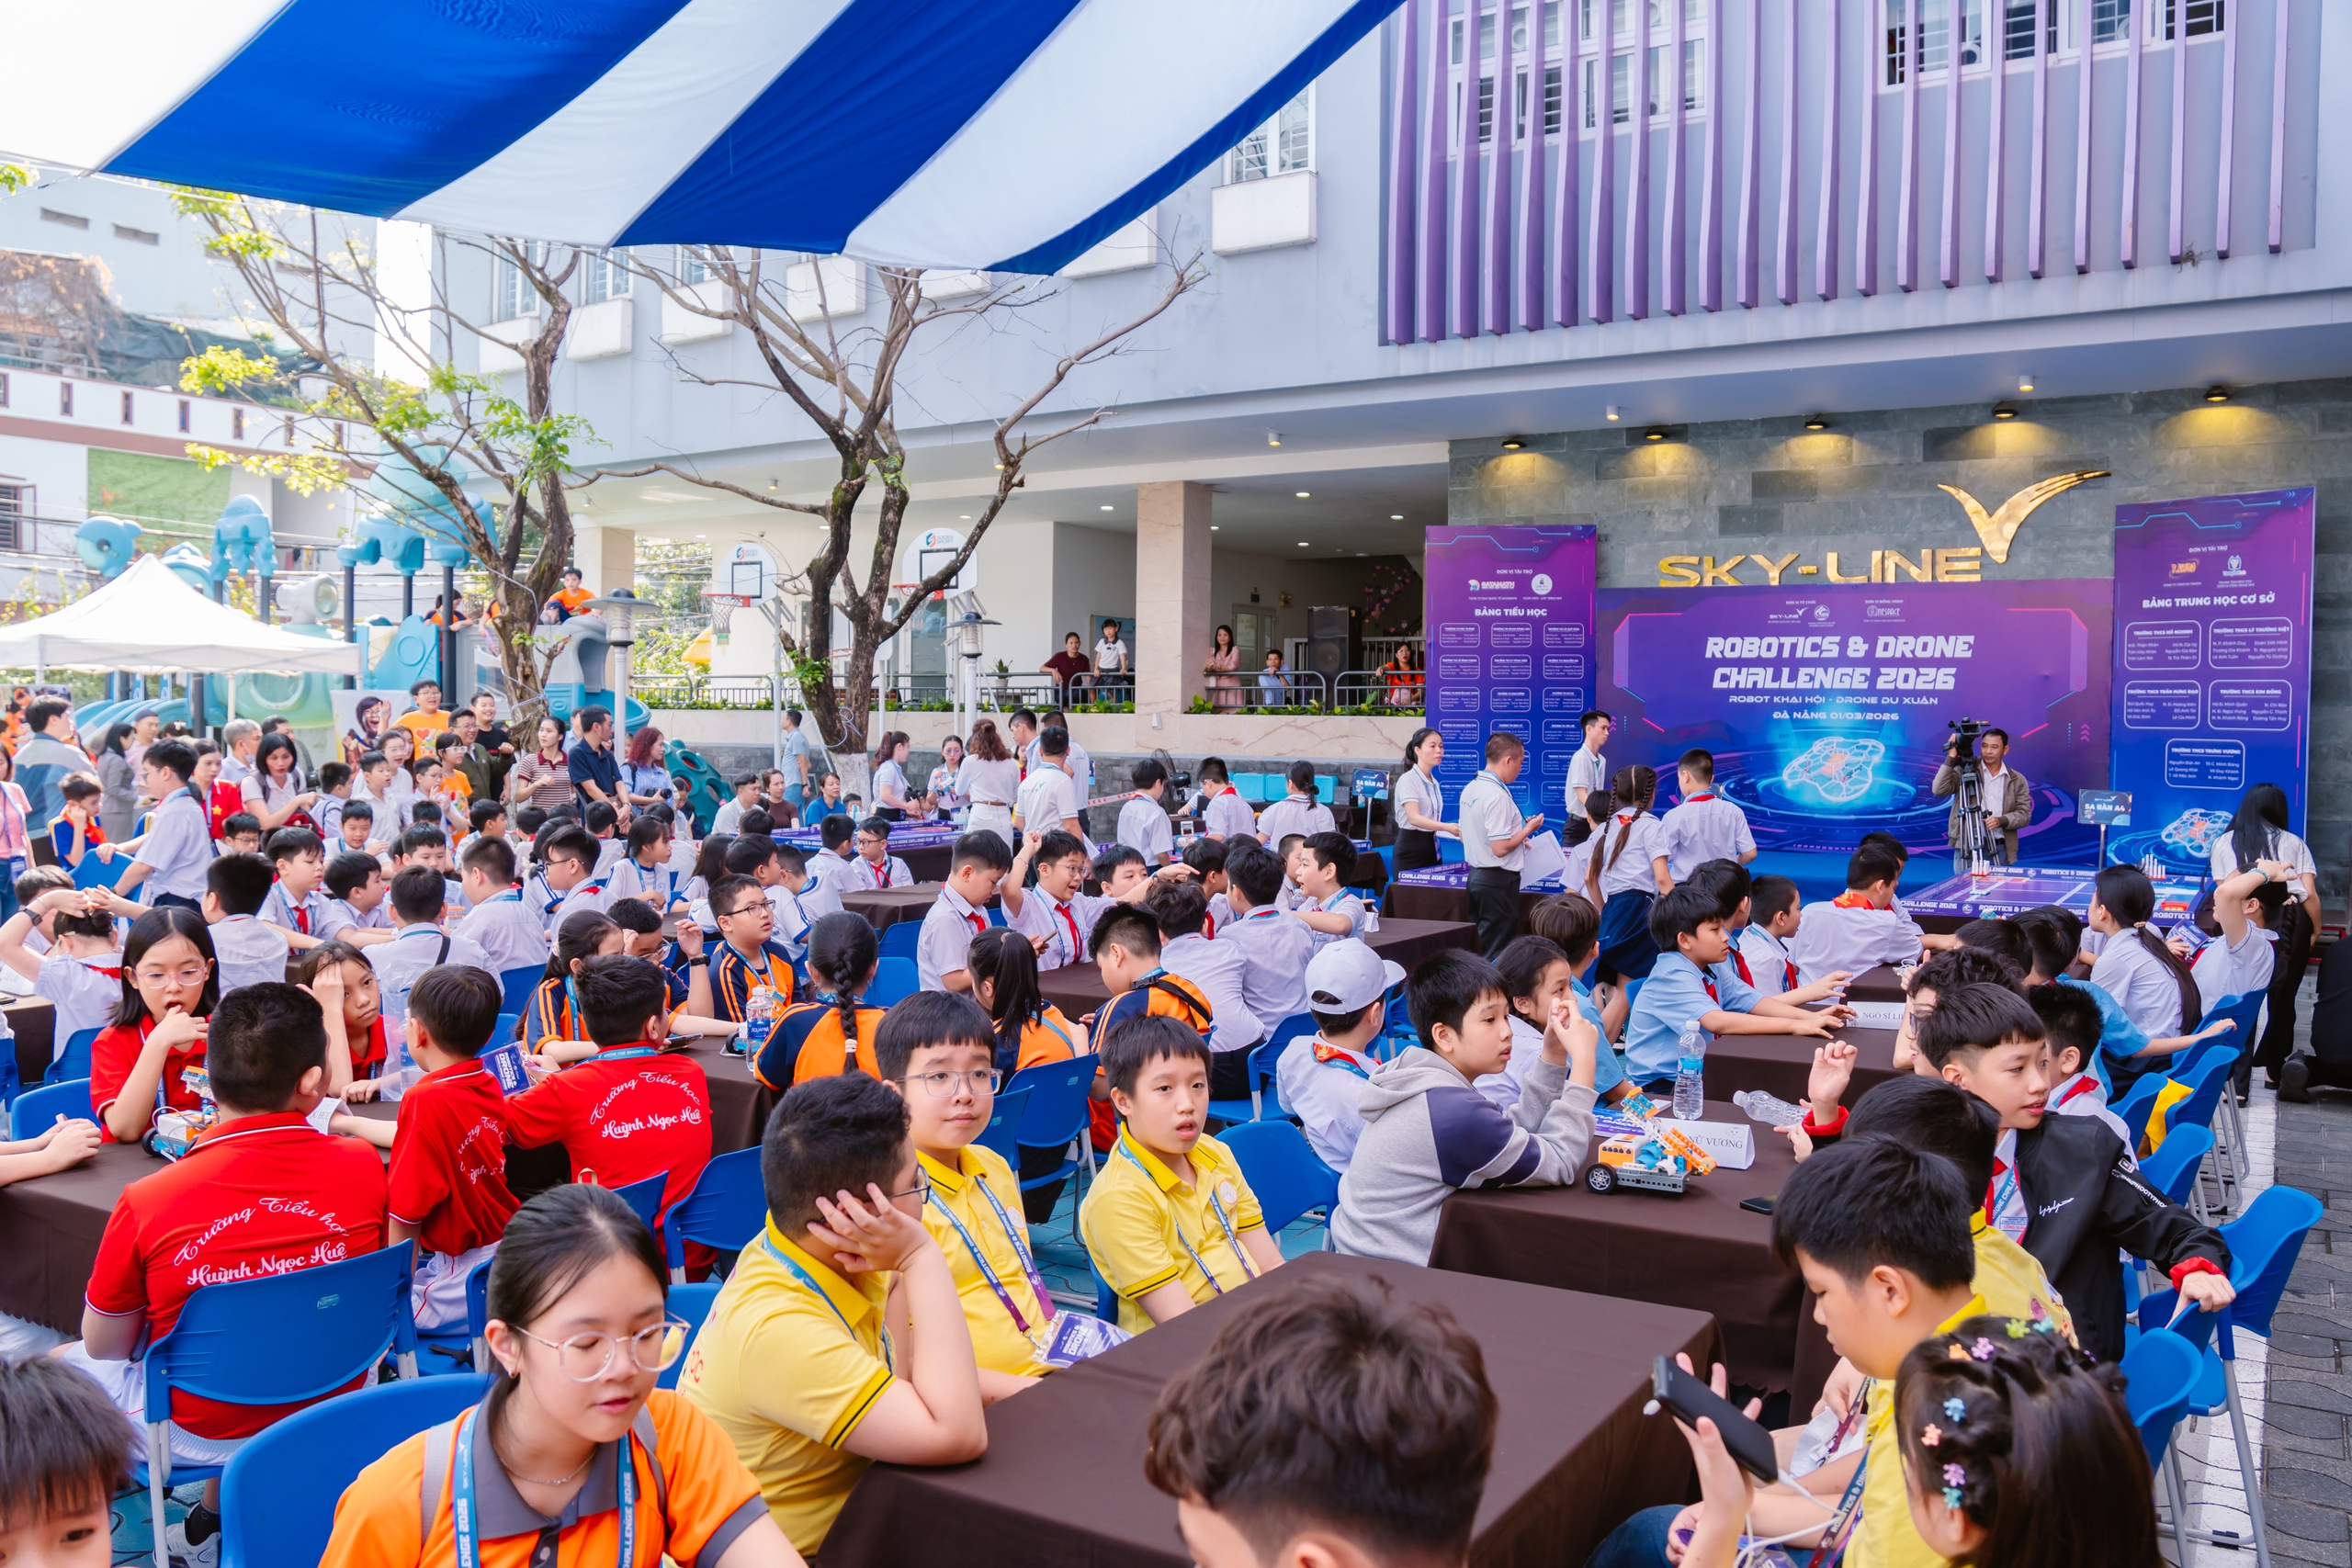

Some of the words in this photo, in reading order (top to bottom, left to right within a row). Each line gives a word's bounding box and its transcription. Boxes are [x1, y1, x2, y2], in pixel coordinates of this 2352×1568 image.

[1658, 547, 1982, 587] SKY-LINE
[1475, 606, 1501, 616] BẢNG
[1504, 606, 1524, 616] TIỂU
[1527, 609, 1547, 617] HỌC
[2143, 596, 2172, 608] BẢNG
[2174, 597, 2211, 607] TRUNG
[2213, 596, 2237, 607] HỌC
[2240, 594, 2256, 604] CƠ
[2259, 591, 2276, 604] SỞ
[1705, 636, 1841, 658] ROBOTICS
[1847, 637, 1869, 658] &
[1875, 635, 1974, 658] DRONE
[1713, 667, 1871, 689] CHALLENGE
[1876, 668, 1957, 689] 2026
[1773, 709, 1790, 719] ĐÀ
[1793, 709, 1827, 719] NẴNG
[1830, 712, 1899, 720] 01/03/2026
[1805, 694, 1826, 705] HỘI
[1902, 695, 1938, 705] XUÂN
[1900, 900, 1938, 908] CHALLENGE
[499, 1053, 514, 1089] DRONE
[590, 1079, 639, 1125] Trường
[639, 1071, 677, 1086] Tiểu
[680, 1082, 701, 1106] học
[601, 1117, 645, 1139] Huỳnh
[646, 1114, 678, 1130] Ngọc
[681, 1106, 702, 1124] Huệ
[1706, 1137, 1743, 1148] VƯƠNG
[174, 1207, 256, 1266] Trường
[259, 1197, 319, 1217] Tiểu
[959, 1226, 974, 1247] DRONE
[1001, 1213, 1014, 1235] DRONE
[187, 1261, 254, 1286] Huỳnh
[257, 1255, 306, 1275] Ngọc
[310, 1241, 348, 1264] Huệ
[976, 1253, 998, 1284] ROBOTICS
[1014, 1241, 1033, 1273] ROBOTICS
[1067, 1325, 1088, 1356] DRONE
[624, 1472, 633, 1504] 2026
[457, 1498, 469, 1532] 2026
